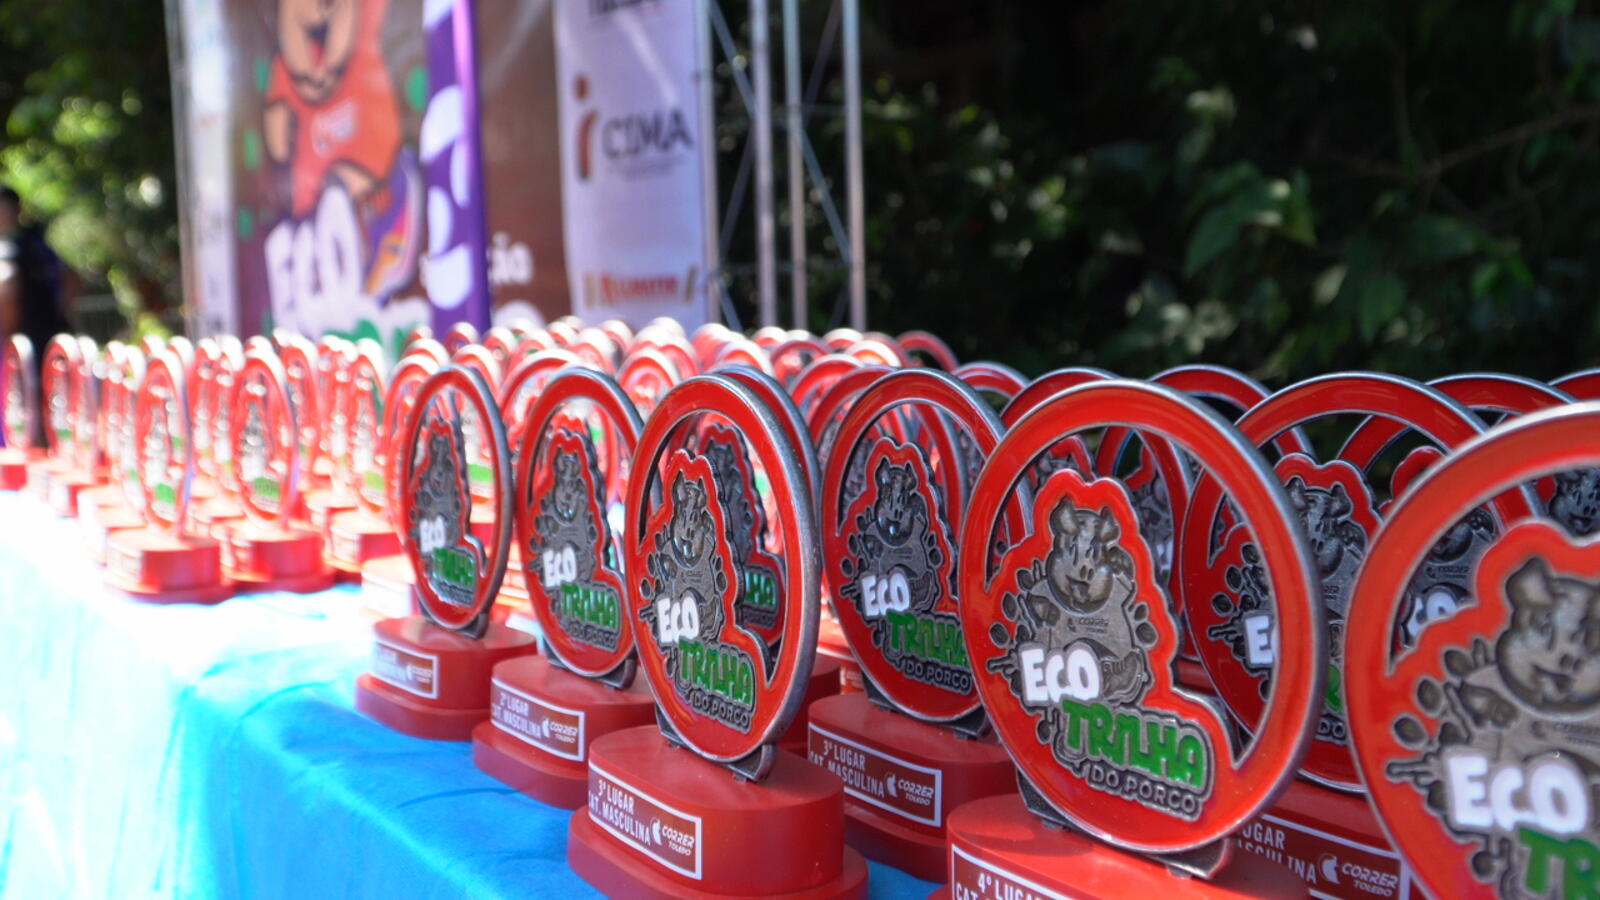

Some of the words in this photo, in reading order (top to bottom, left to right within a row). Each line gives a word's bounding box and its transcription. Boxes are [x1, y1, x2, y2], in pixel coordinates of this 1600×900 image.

[543, 546, 577, 587] ECO
[861, 572, 911, 617] ECO
[656, 596, 700, 643] ECO
[906, 659, 924, 678] DO
[926, 666, 970, 689] PORCO
[1021, 648, 1100, 703] ECO
[711, 700, 749, 728] PORCO
[833, 744, 866, 771] LUGAR
[1062, 699, 1204, 789] TRILHA
[828, 759, 885, 798] MASCULINA
[897, 779, 935, 799] CORRER
[1091, 765, 1119, 788] DO
[1123, 776, 1197, 813] PORCO
[606, 784, 634, 815] LUGAR
[1448, 754, 1589, 835] ECO
[602, 802, 651, 845] MASCULINA
[661, 825, 695, 849] CORRER
[1242, 822, 1286, 850] UGAR
[994, 879, 1043, 900] LUG
[1341, 862, 1399, 889] CORRER
[1353, 879, 1393, 897] TOLEDO
